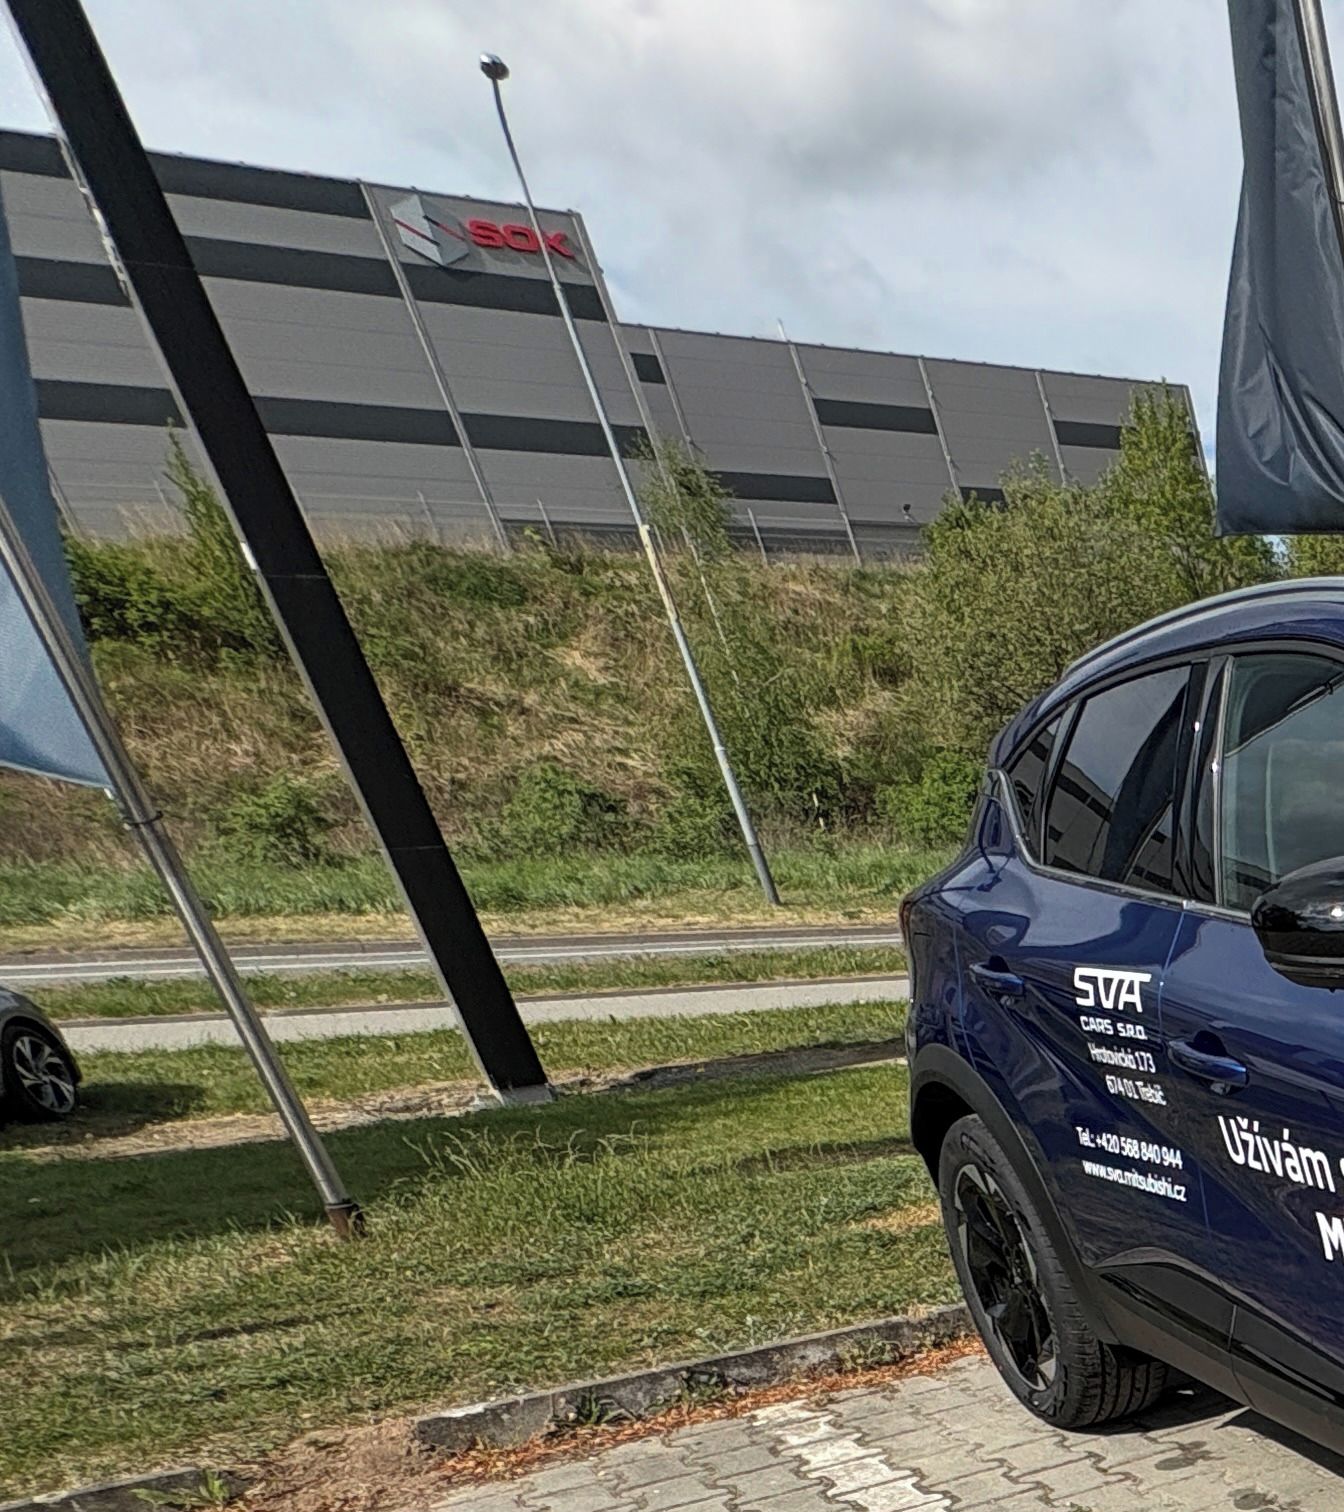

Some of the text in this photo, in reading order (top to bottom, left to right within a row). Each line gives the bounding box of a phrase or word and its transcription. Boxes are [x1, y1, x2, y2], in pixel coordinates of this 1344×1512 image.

[1079, 1015, 1114, 1035] CARS
[1134, 1050, 1157, 1074] 173
[1105, 1074, 1126, 1097] 674
[1123, 1078, 1140, 1100] 01
[1095, 1132, 1120, 1155] +420
[1119, 1136, 1141, 1160] 568
[1140, 1141, 1161, 1165] 840
[1161, 1146, 1183, 1170] 944
[1216, 1114, 1336, 1193] Užívám
